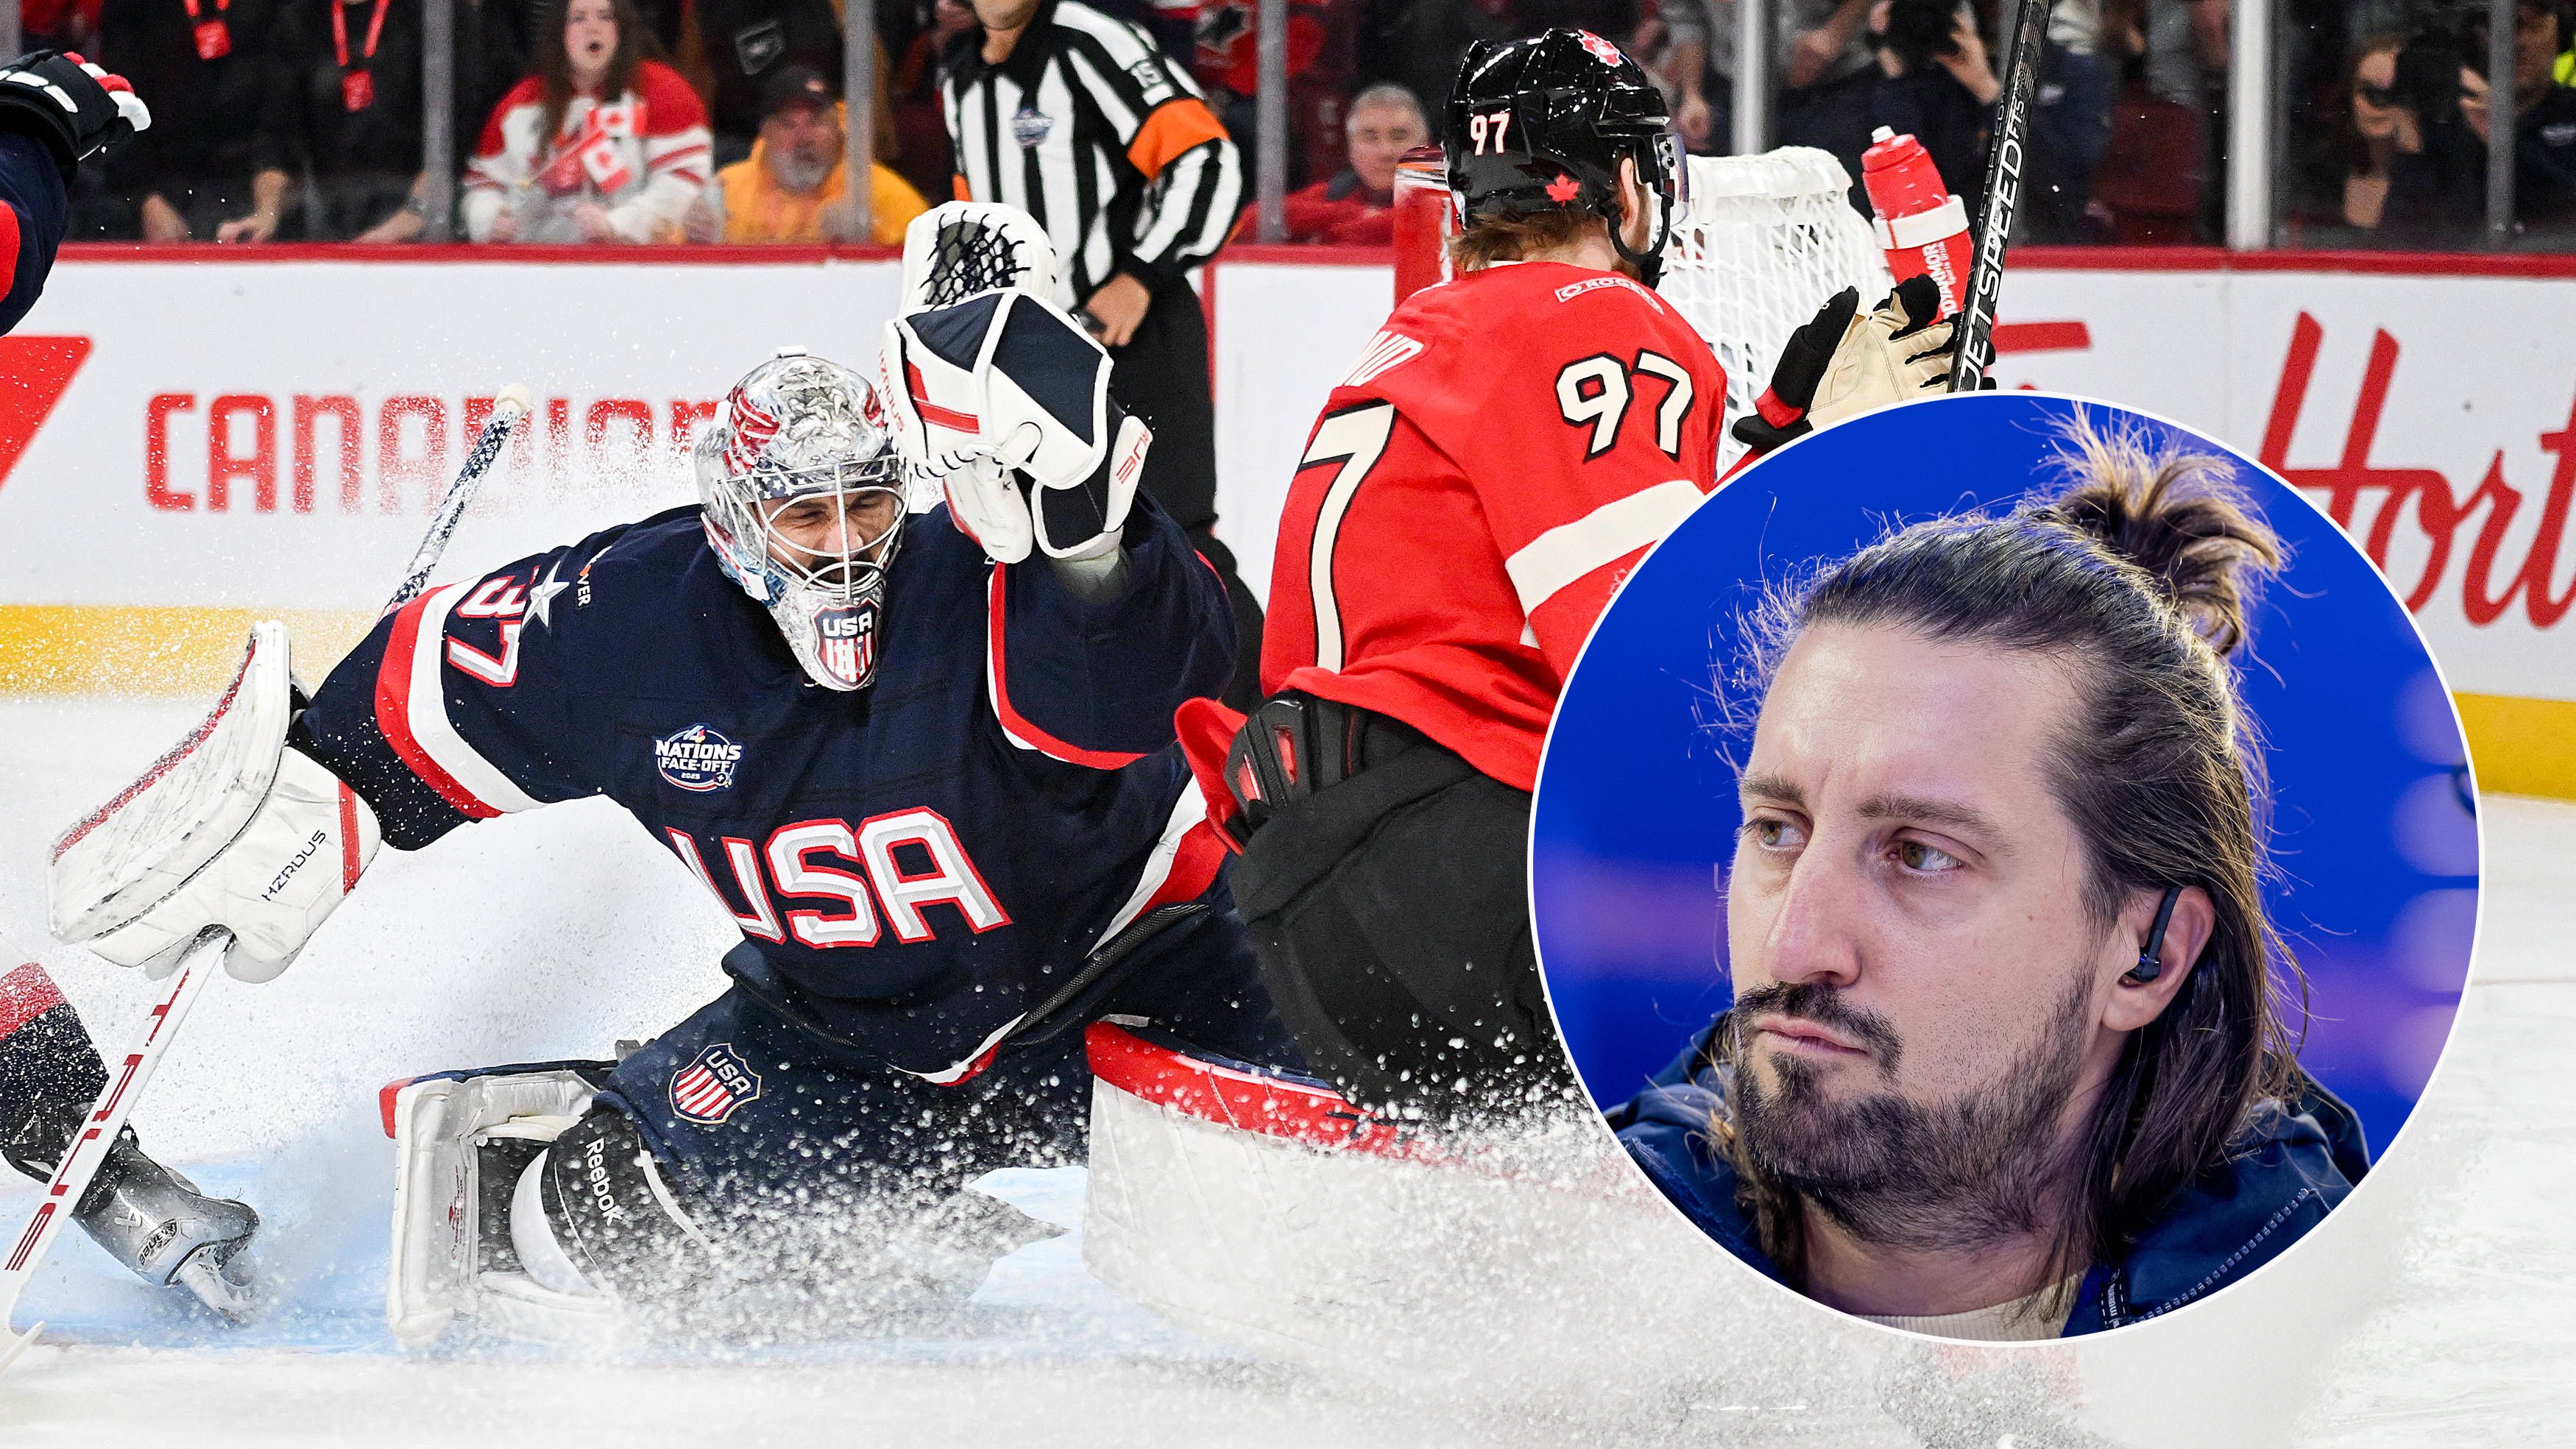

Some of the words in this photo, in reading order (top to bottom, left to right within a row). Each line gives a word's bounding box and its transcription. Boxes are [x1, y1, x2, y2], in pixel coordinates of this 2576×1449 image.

[1471, 113, 1510, 156] 97
[1954, 138, 2023, 392] JETSPEED
[1554, 347, 1694, 465] 97
[822, 611, 872, 637] USA
[655, 740, 742, 760] NATIONS
[662, 757, 731, 773] FACE-OFF
[665, 806, 1013, 949] USA
[706, 1050, 751, 1095] USA
[585, 1137, 623, 1227] Reebok
